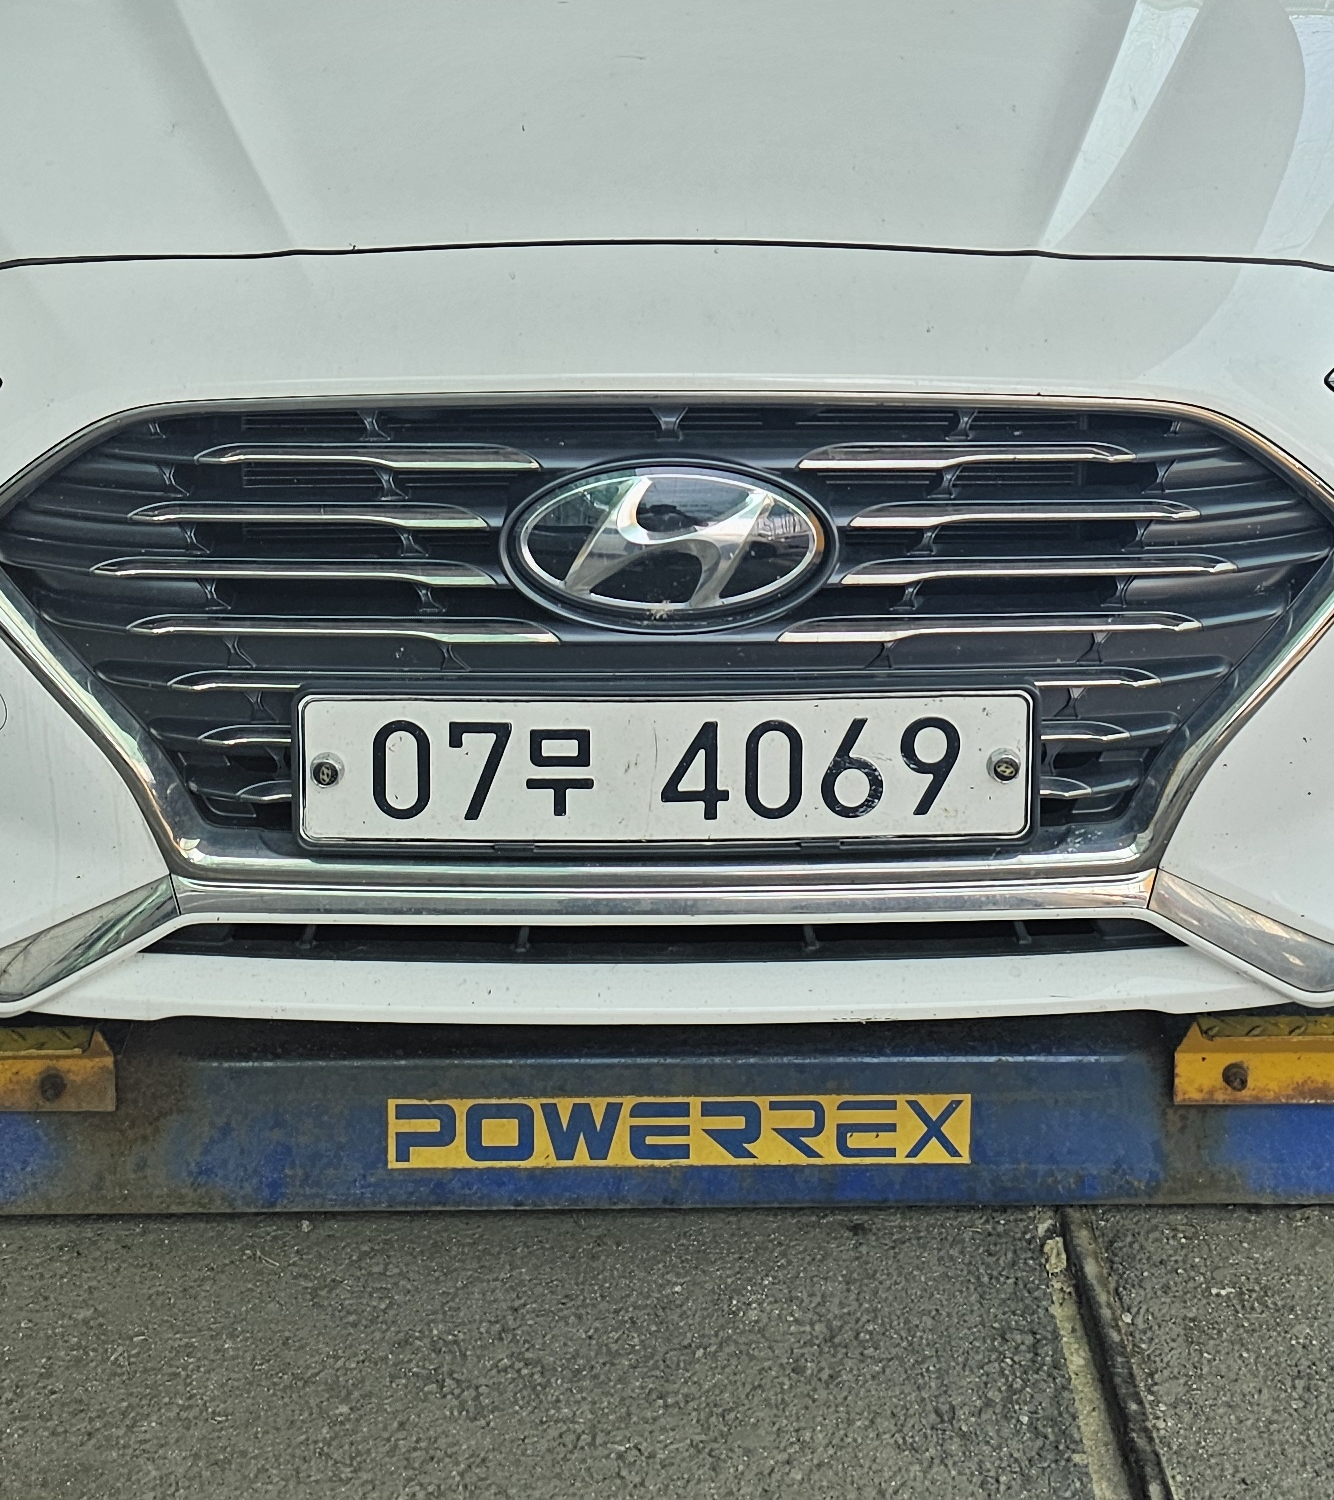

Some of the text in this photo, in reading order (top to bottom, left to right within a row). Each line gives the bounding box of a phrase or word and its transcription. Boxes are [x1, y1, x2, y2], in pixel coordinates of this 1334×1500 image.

[371, 716, 963, 821] 07무 4069
[394, 1098, 963, 1162] POWERREX
